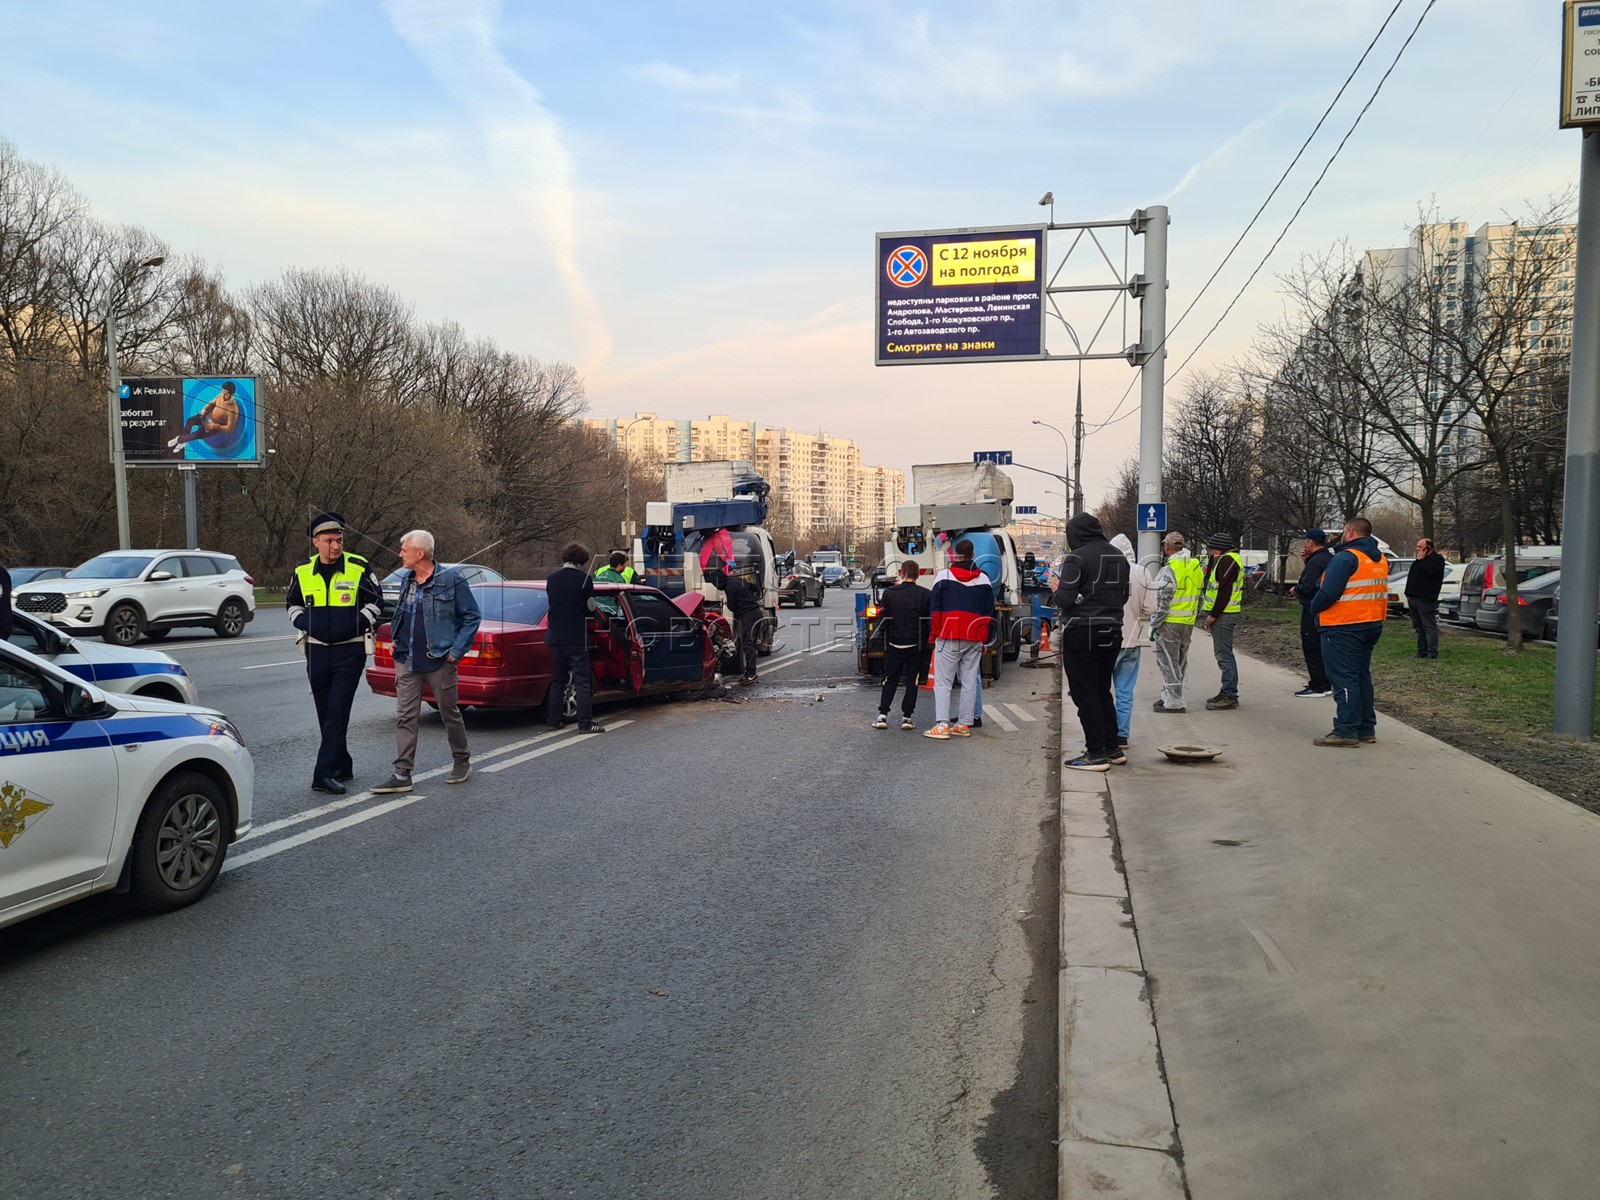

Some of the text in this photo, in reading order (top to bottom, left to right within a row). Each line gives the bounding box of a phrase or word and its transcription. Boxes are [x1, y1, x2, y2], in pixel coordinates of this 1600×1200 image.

[940, 245, 1027, 260] С 12 ноября
[940, 265, 1019, 278] на полгода
[887, 298, 934, 306] недоступны
[935, 296, 973, 305] парковки
[981, 294, 1011, 303] районе
[1012, 293, 1040, 302] просп.
[887, 304, 1031, 316] Андропова, Мастеркова, Ленинская
[887, 318, 923, 326] Слобода,
[925, 317, 941, 325] 1-го
[942, 315, 998, 324] Кожуховского
[887, 326, 981, 336] 1-го Автозаводского пр.
[886, 341, 995, 354] Смотрите на знаки
